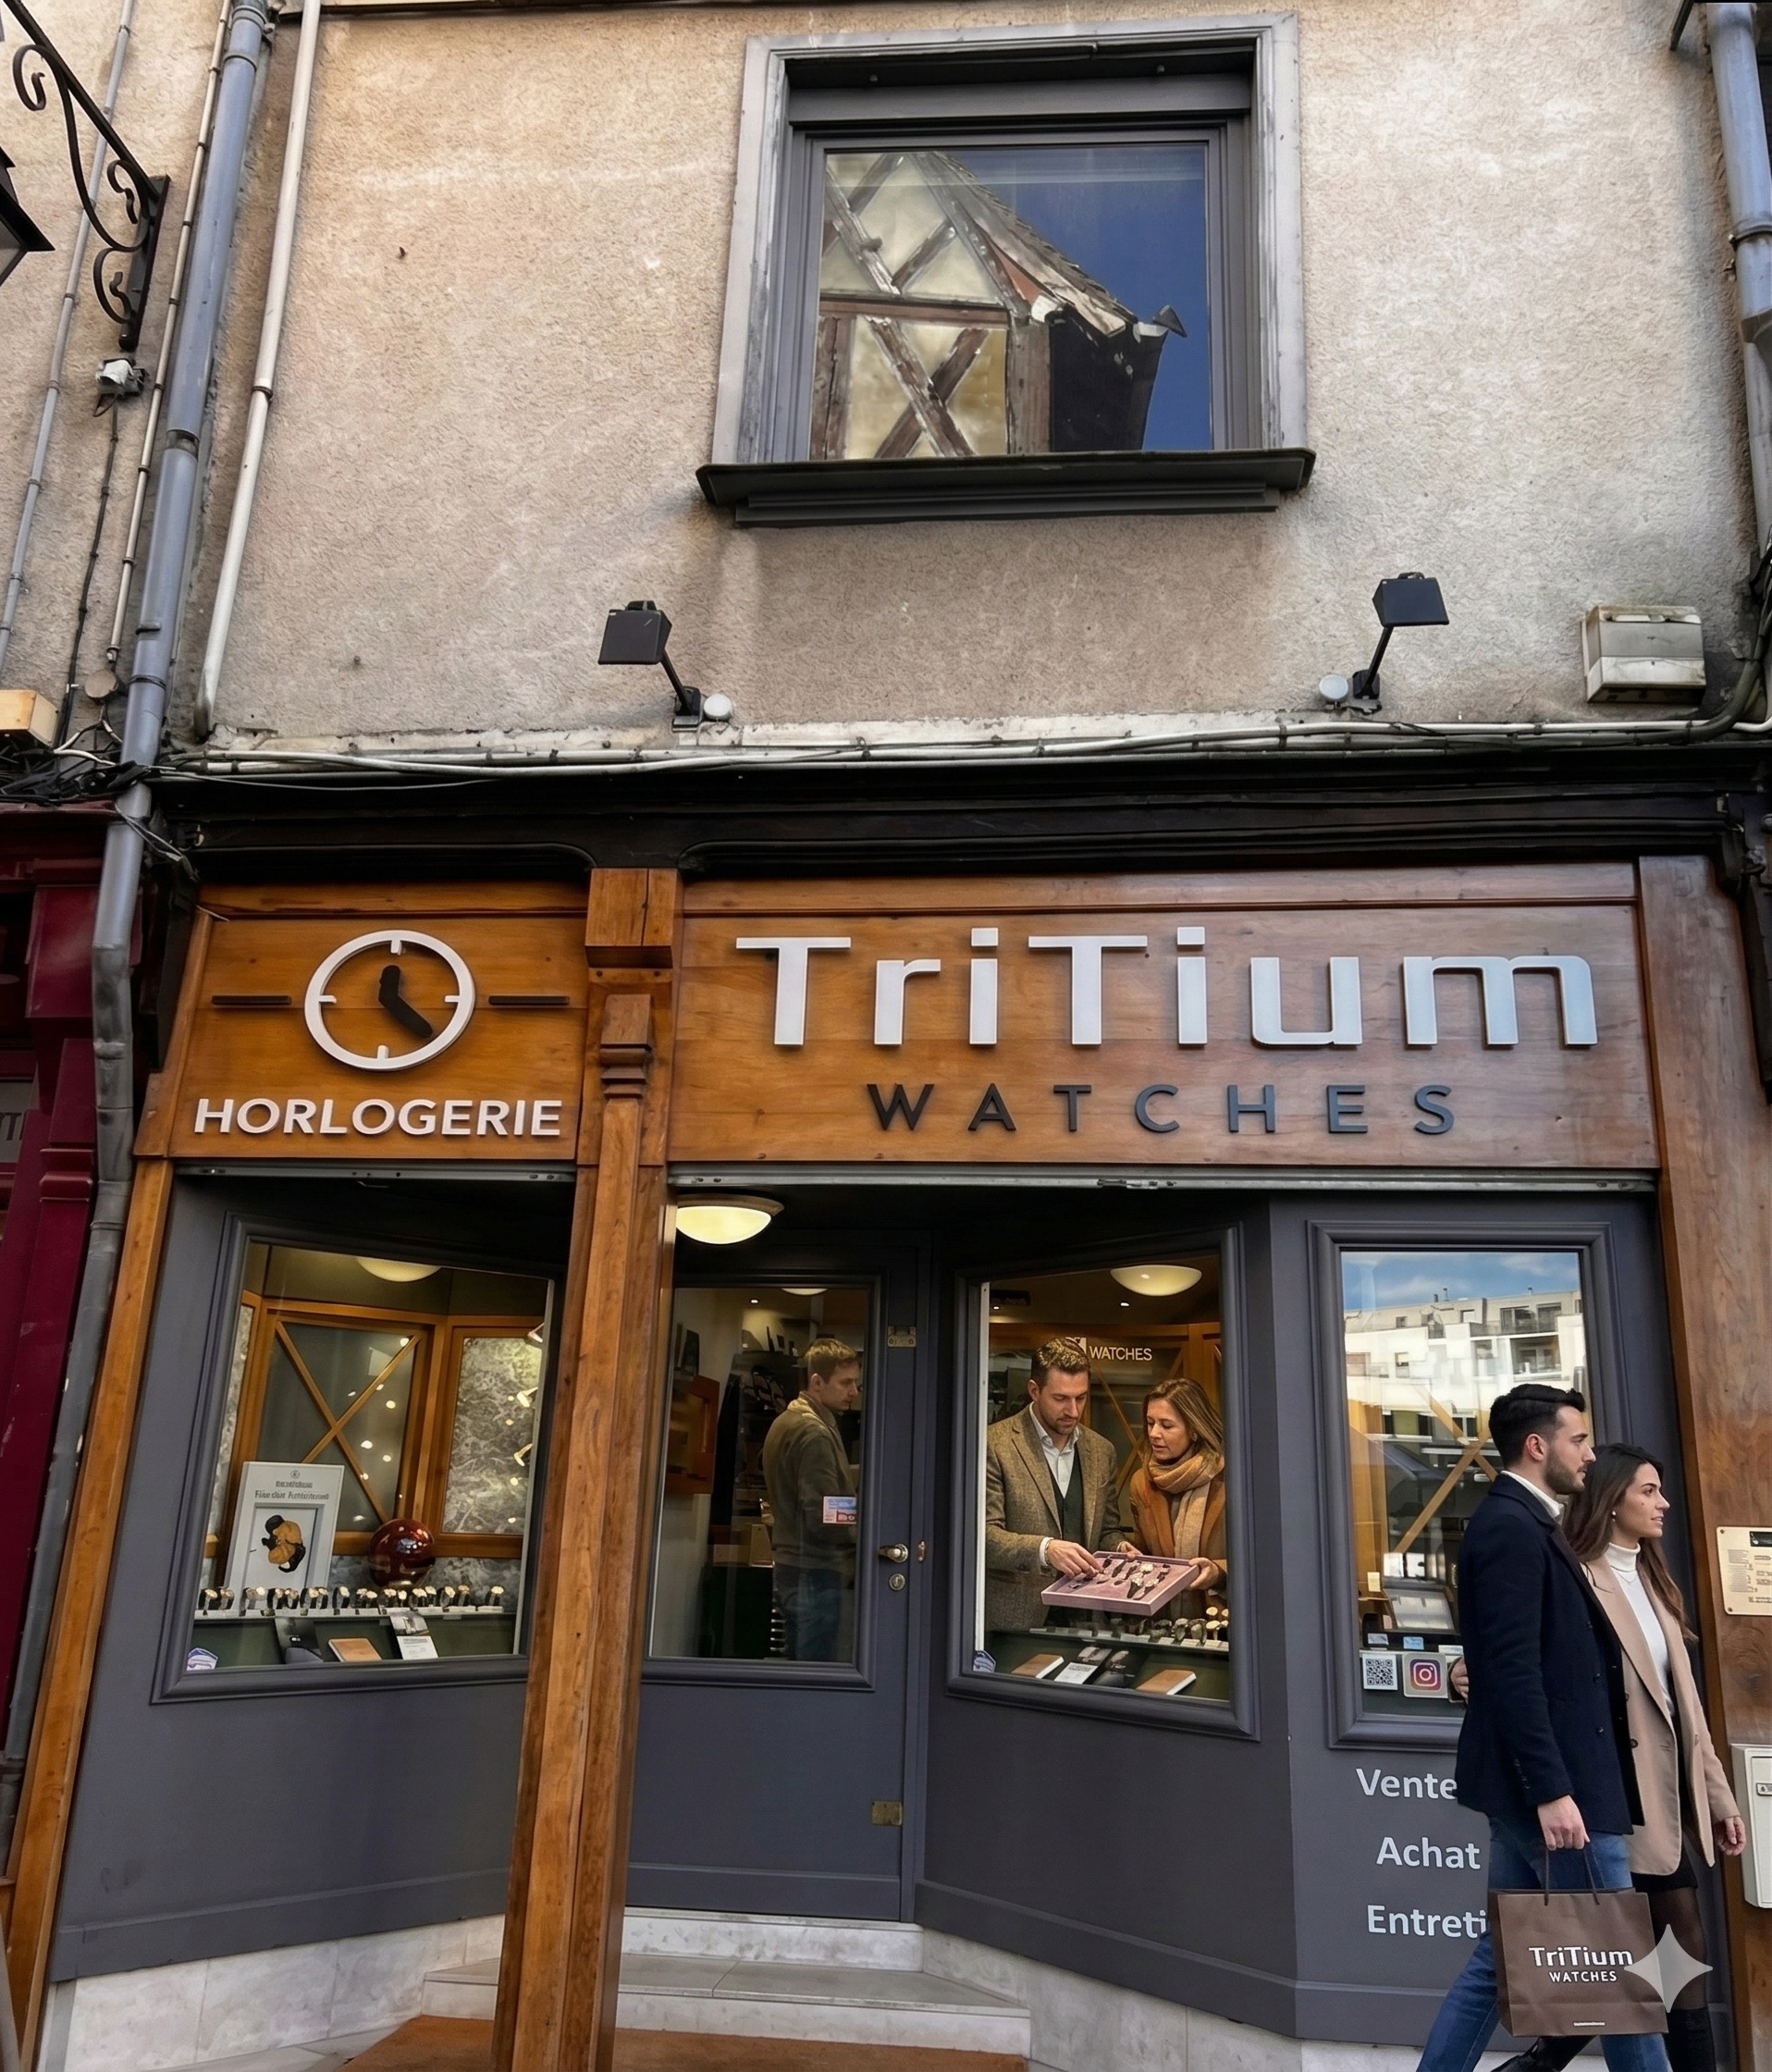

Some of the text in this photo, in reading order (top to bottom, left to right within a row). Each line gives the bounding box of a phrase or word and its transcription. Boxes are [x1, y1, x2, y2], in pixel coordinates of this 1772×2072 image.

[735, 926, 1599, 1047] TriTium
[193, 1097, 563, 1137] HORLOGERIE
[866, 1082, 1456, 1136] WATCHES
[1089, 1345, 1153, 1362] WATCHES
[1355, 1768, 1458, 1800] Vente
[1375, 1836, 1482, 1870] Achat
[1367, 1904, 1488, 1940] Entreti
[1528, 1946, 1634, 1967] TriTium
[1548, 1970, 1618, 1983] WATCHES
